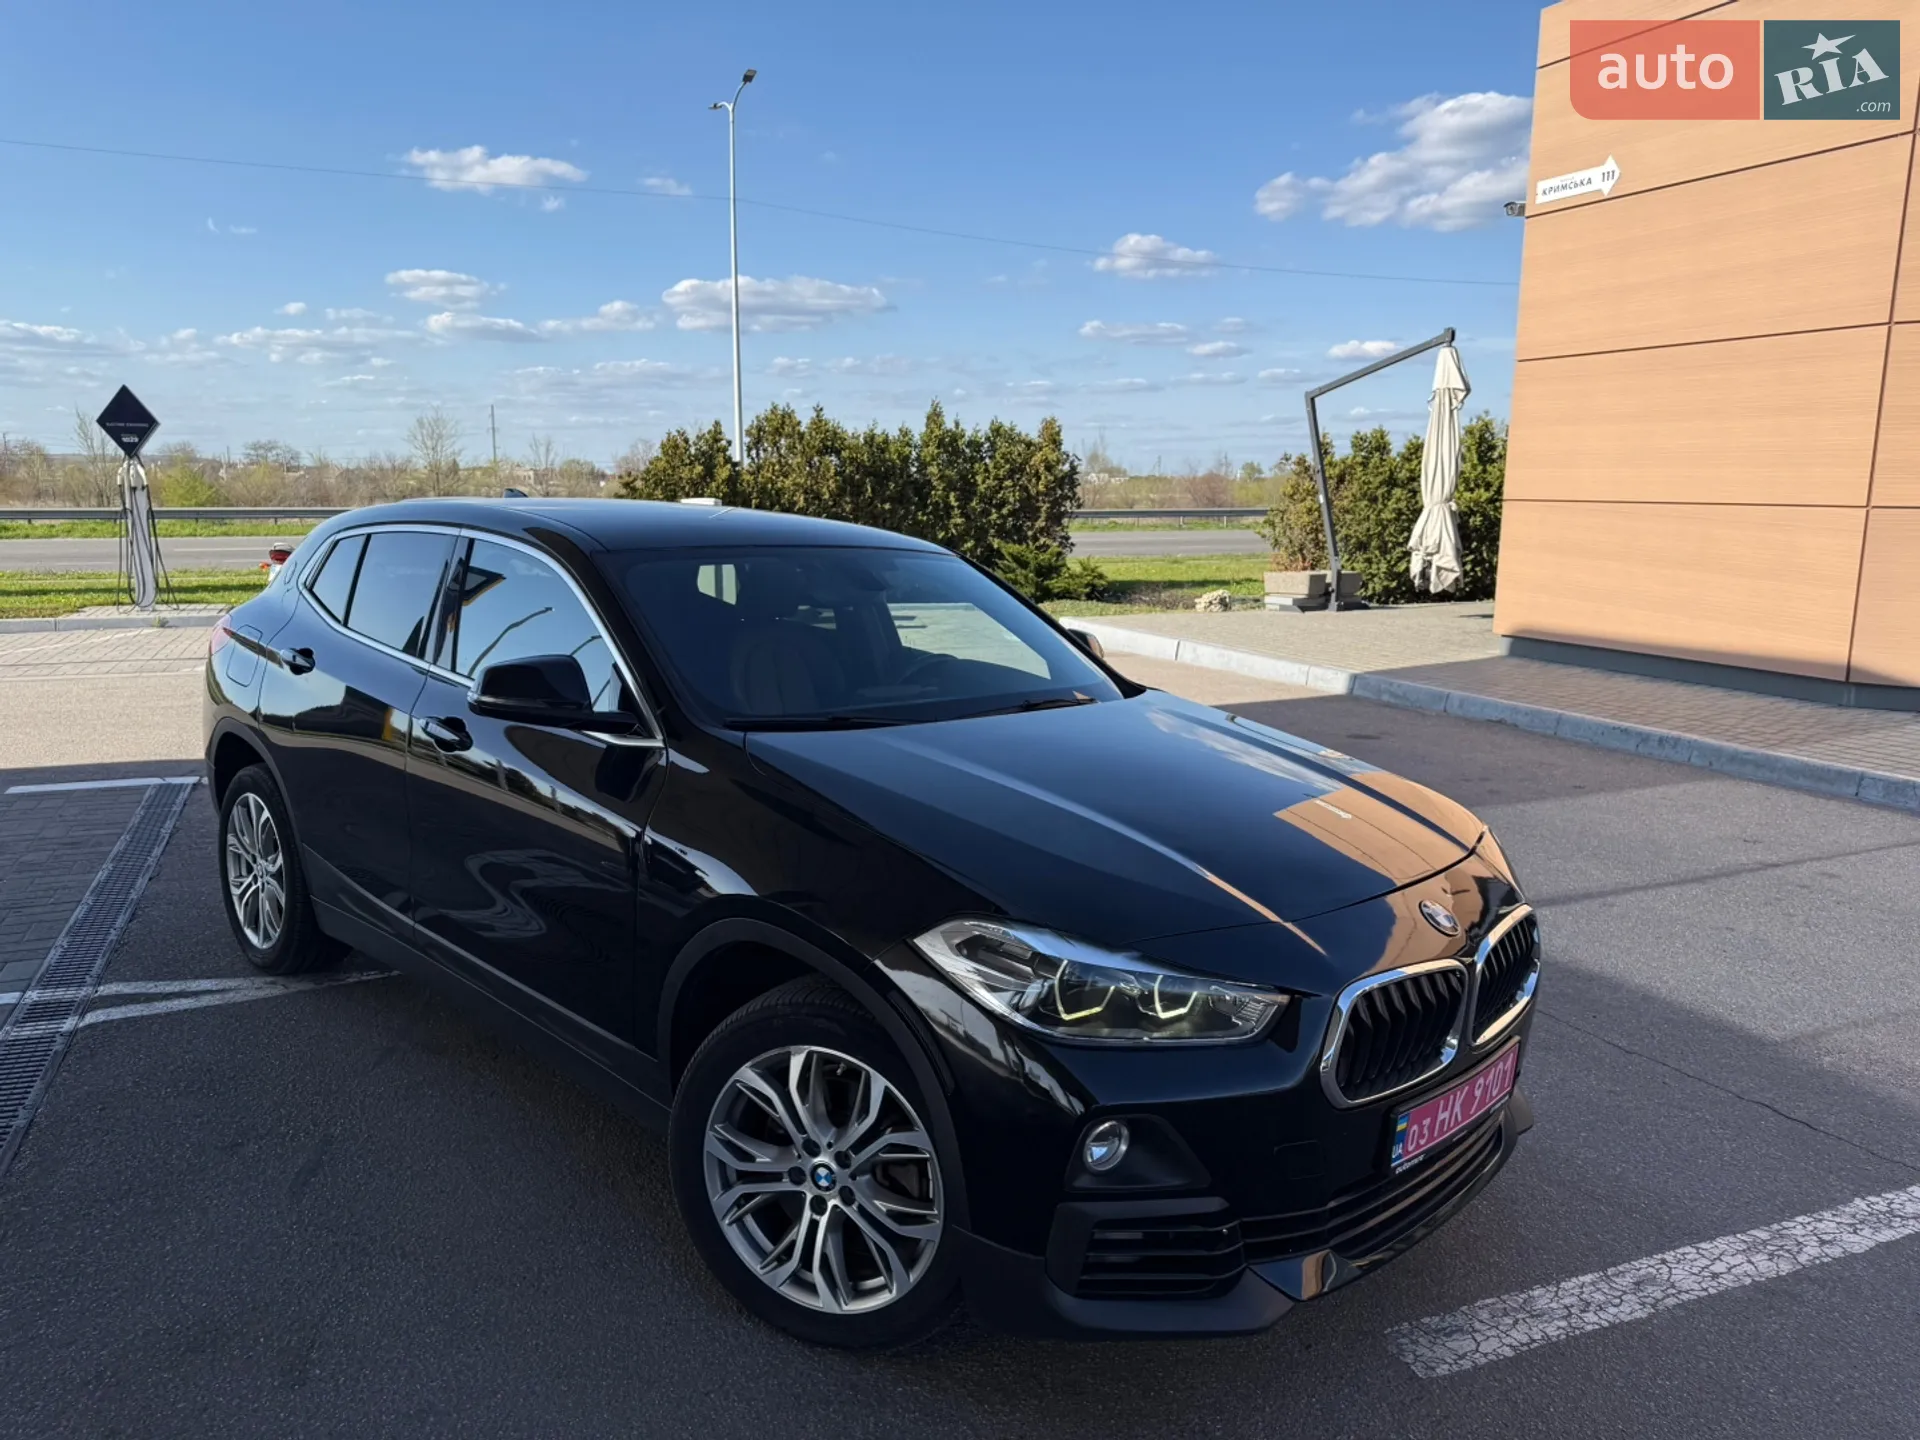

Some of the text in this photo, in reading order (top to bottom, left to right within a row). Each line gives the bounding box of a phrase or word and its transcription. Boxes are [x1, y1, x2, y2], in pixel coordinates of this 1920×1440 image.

[1541, 177, 1592, 196] КРИМСЬКА
[1602, 169, 1615, 182] 111
[1407, 1118, 1431, 1152] 03
[1469, 1052, 1514, 1115] 9101
